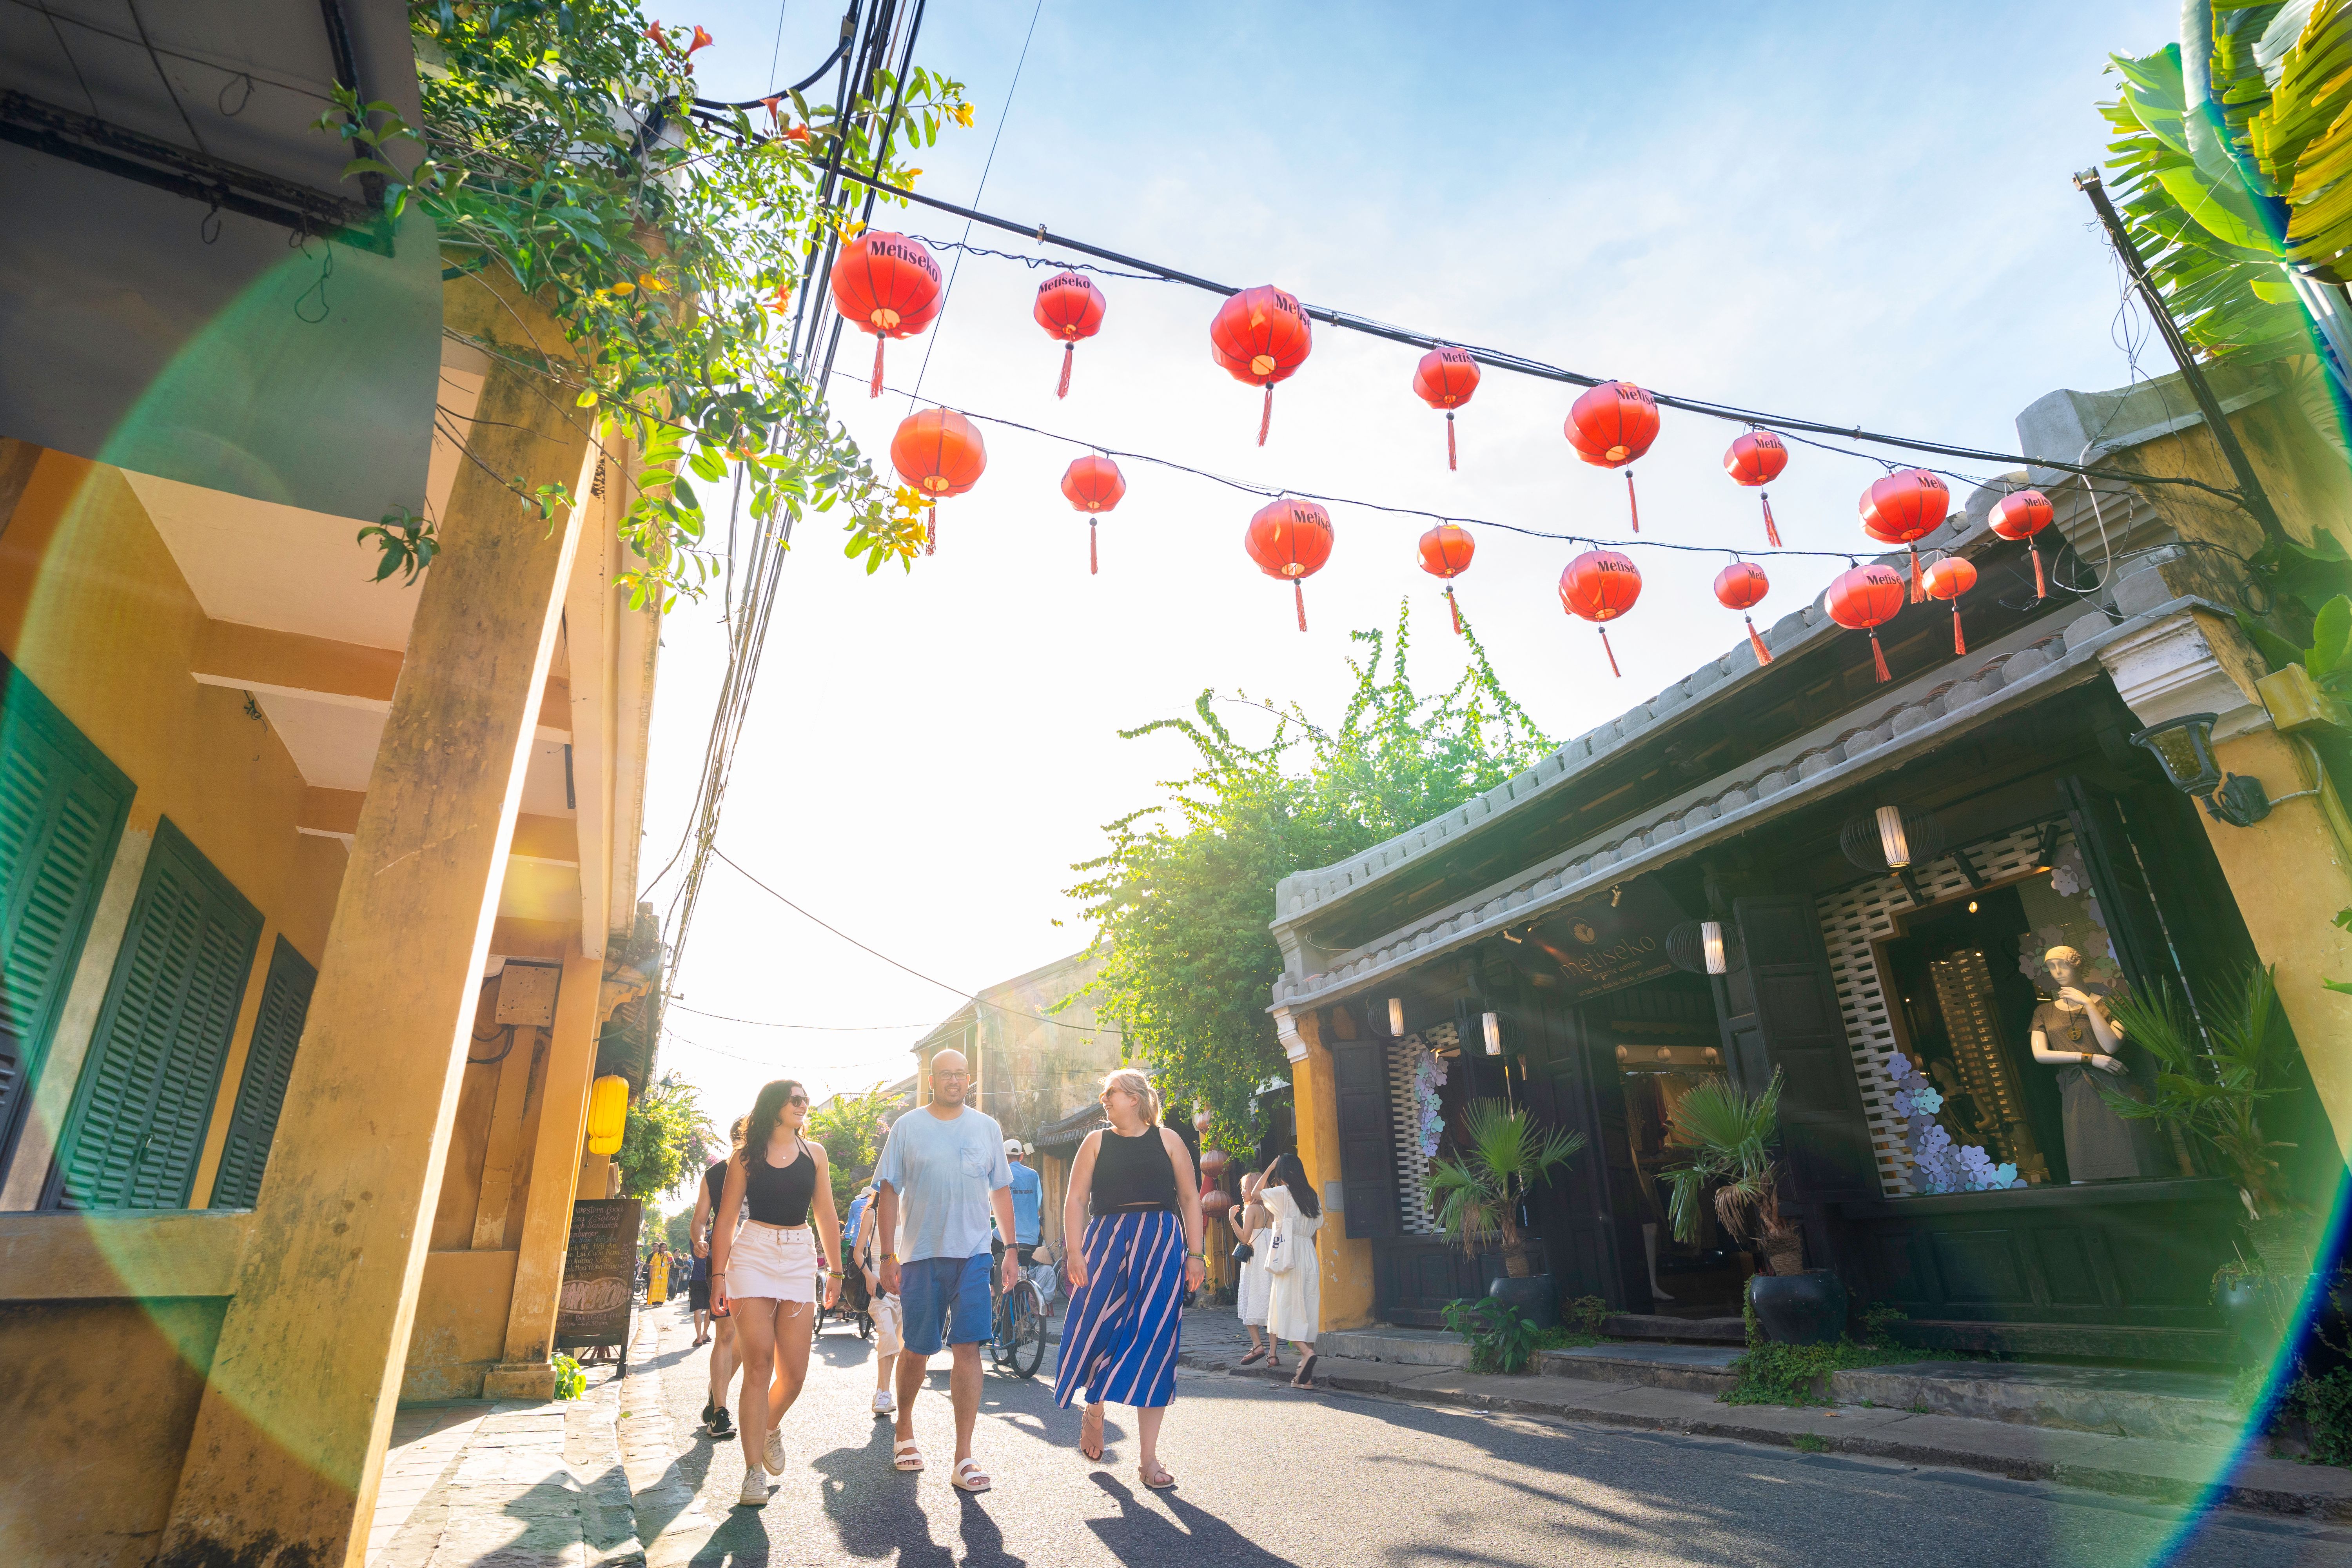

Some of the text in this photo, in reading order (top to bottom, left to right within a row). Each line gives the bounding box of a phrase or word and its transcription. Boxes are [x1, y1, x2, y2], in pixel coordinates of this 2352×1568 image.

[871, 241, 938, 282] Metiseko
[1039, 276, 1090, 294] Metiseko
[1615, 388, 1657, 410] Metise
[1559, 936, 1656, 979] metiseko
[1593, 960, 1642, 980] organic cotton
[569, 1229, 599, 1239] amburger
[587, 1221, 619, 1229] Sandwich
[575, 1314, 586, 1323] Buy
[608, 1312, 621, 1321] free
